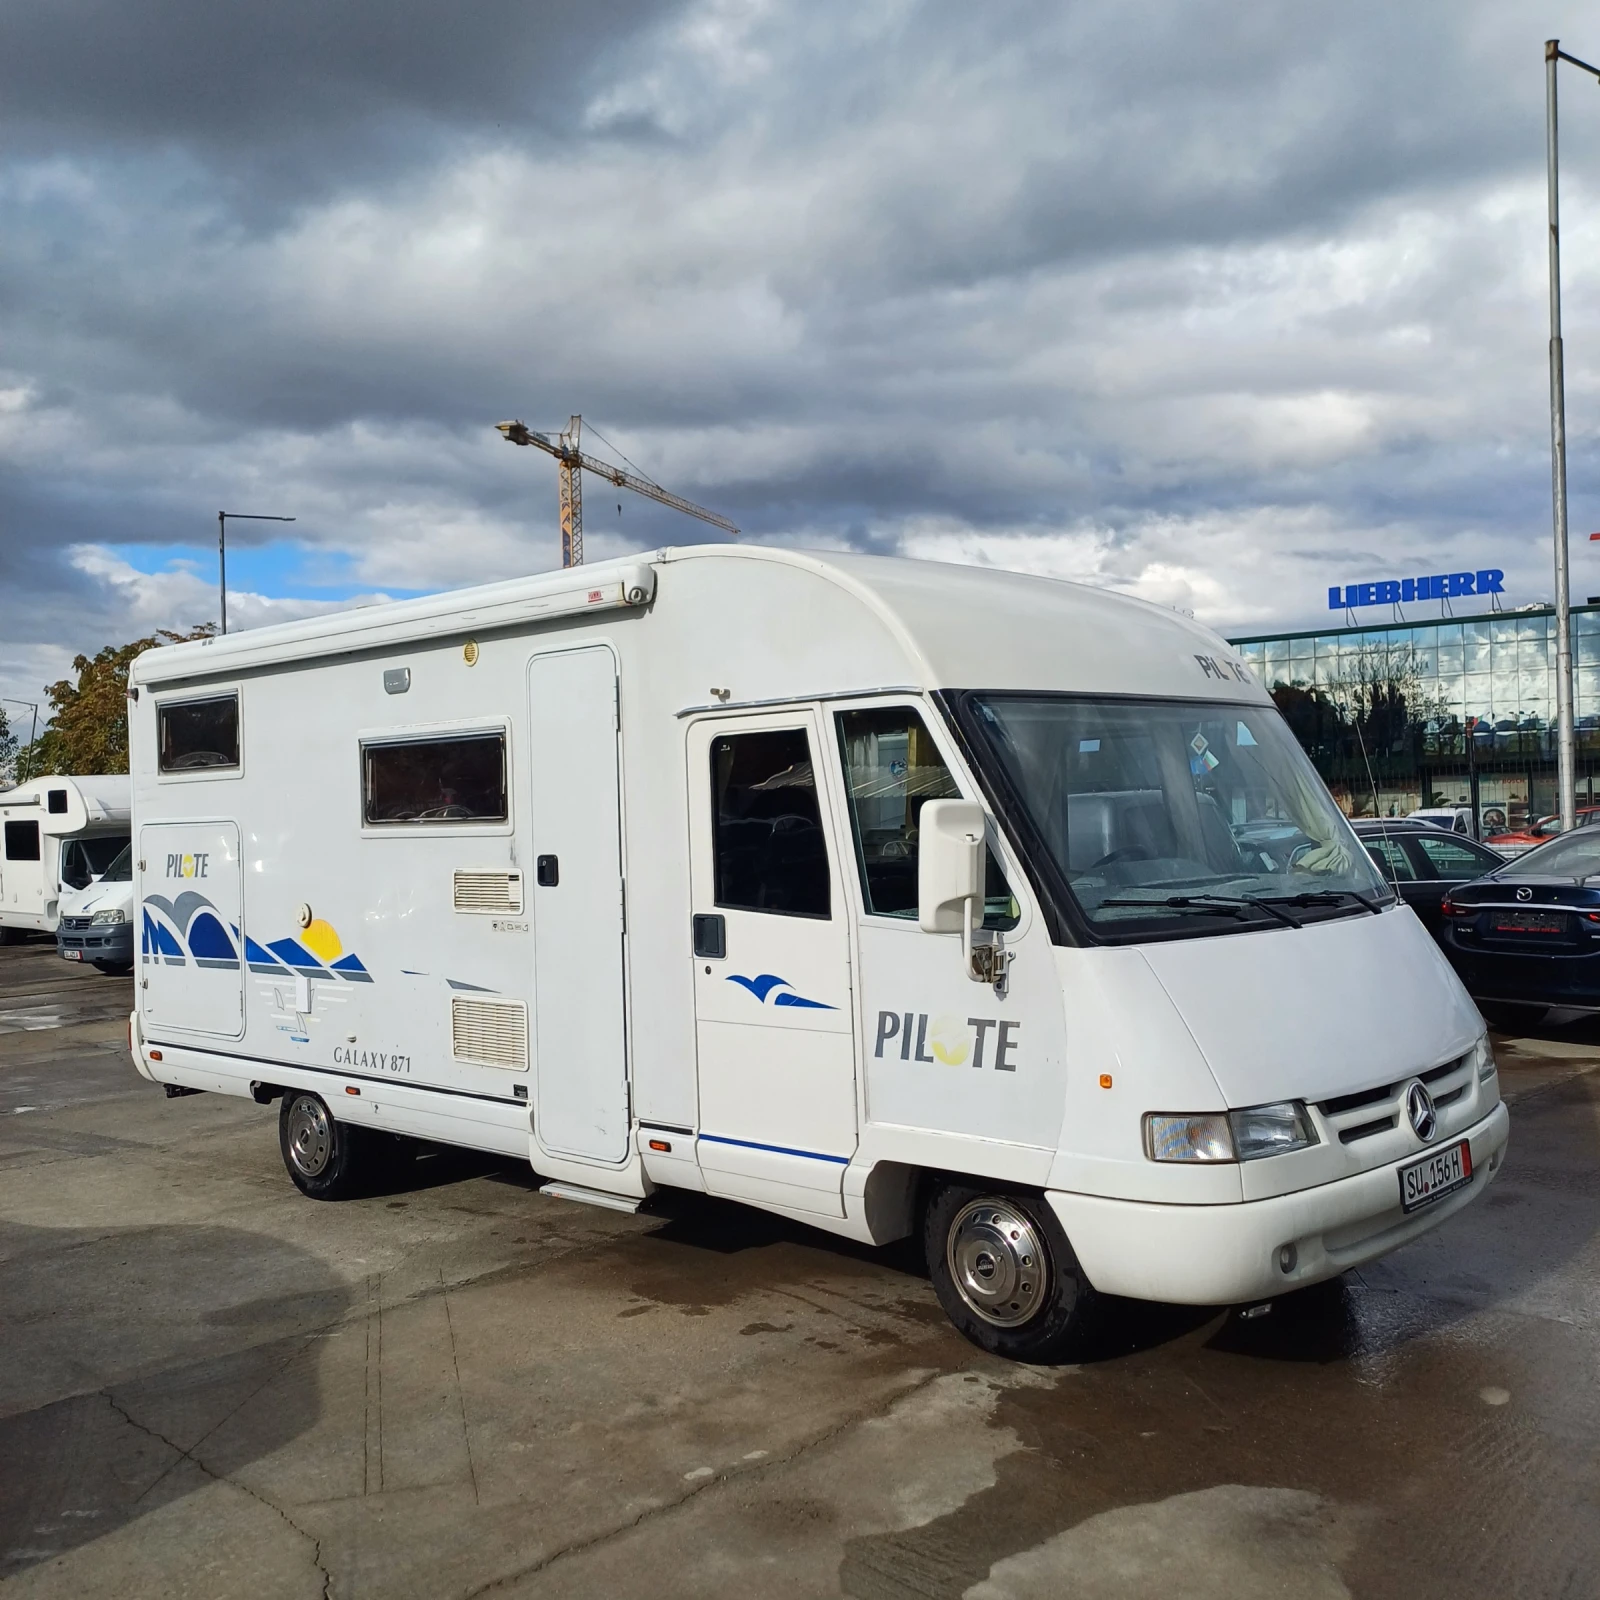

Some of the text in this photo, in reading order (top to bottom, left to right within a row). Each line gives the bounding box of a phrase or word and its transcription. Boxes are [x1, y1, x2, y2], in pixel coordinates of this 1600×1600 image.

[1328, 568, 1506, 610] LIEBHERR
[1193, 654, 1251, 685] PILTE
[166, 853, 209, 878] PILOTE
[333, 1046, 411, 1073] GALAXY 871
